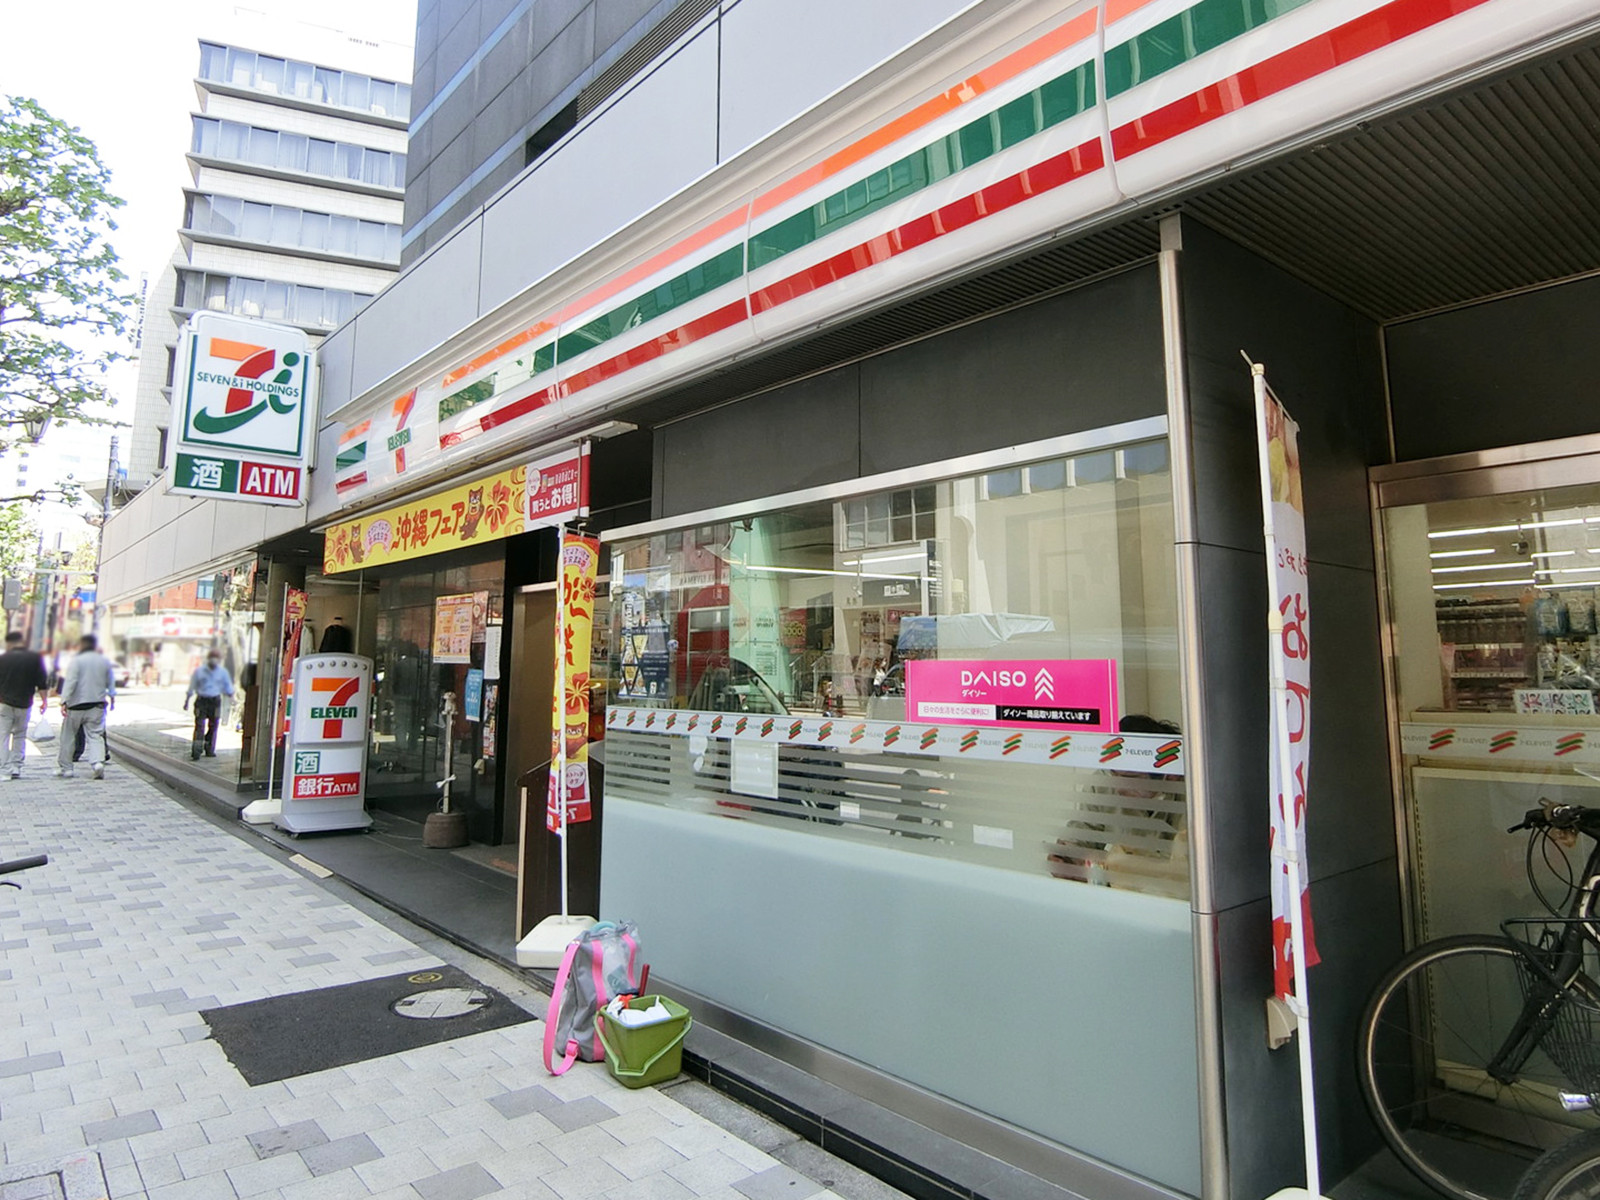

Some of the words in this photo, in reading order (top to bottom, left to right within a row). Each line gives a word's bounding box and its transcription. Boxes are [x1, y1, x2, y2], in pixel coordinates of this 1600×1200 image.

[246, 380, 299, 398] HOLDINGS
[190, 458, 224, 489] 酒
[245, 466, 295, 496] ATM
[391, 501, 465, 551] 沖縄フェア
[961, 670, 1027, 687] DAISO
[961, 688, 987, 698] ダイソー
[296, 752, 319, 775] 酒
